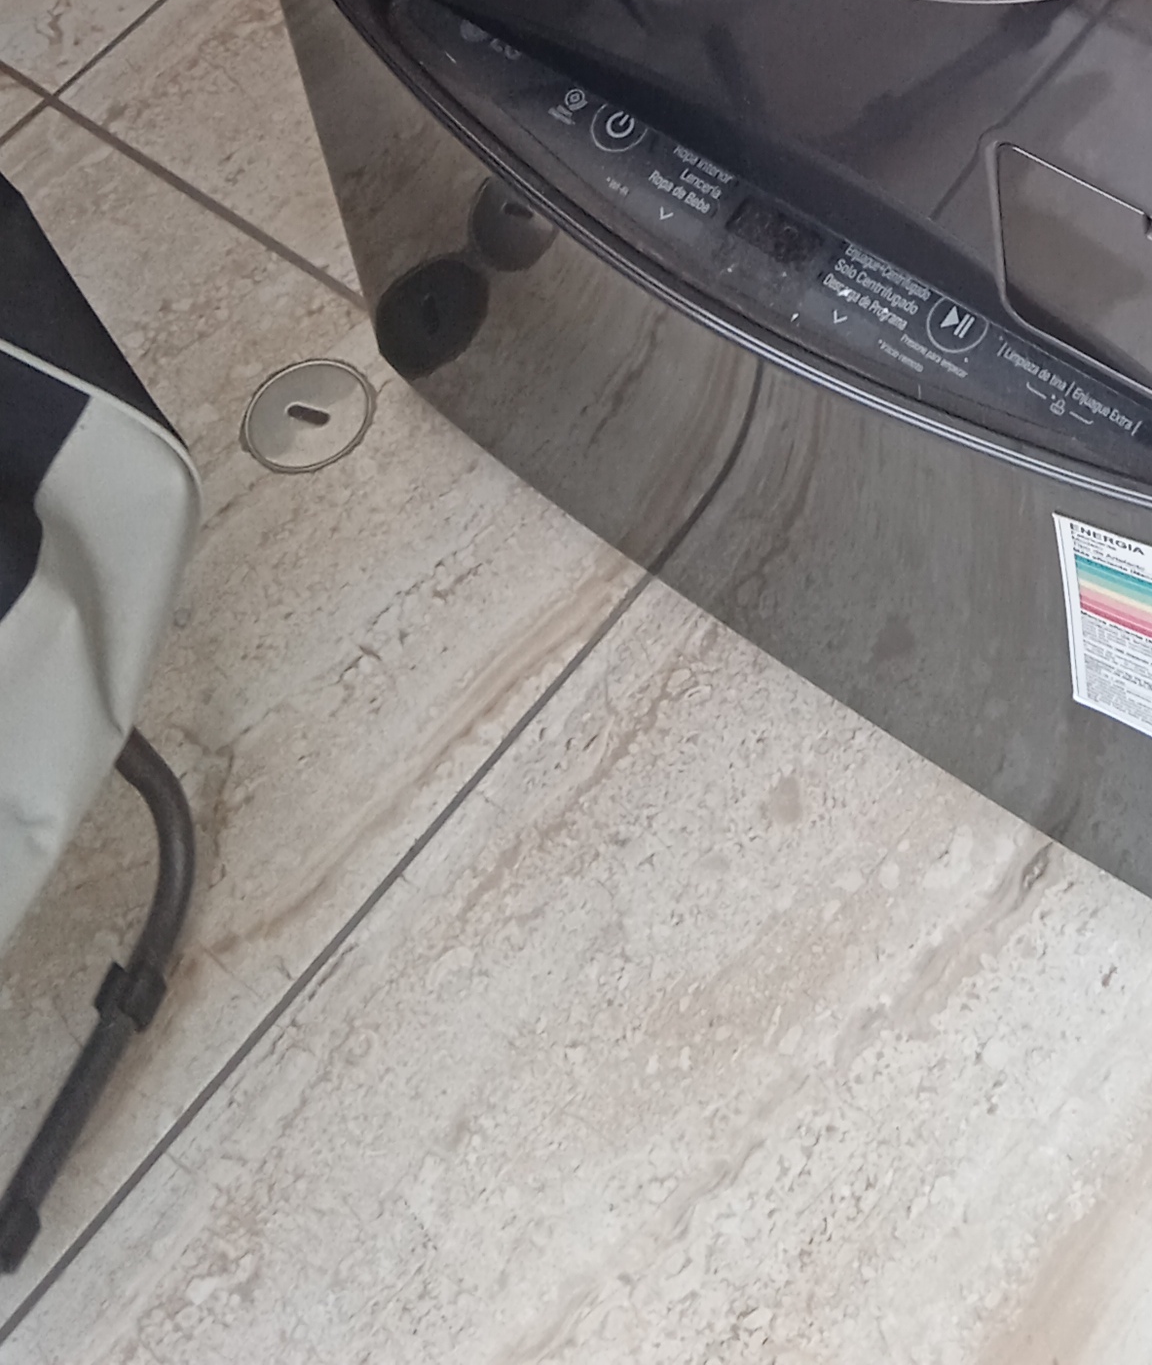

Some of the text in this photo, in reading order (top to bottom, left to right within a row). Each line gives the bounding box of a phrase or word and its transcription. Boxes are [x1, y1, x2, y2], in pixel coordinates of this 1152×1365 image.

[648, 170, 674, 194] Ropa
[856, 270, 919, 316] Centrifugado
[1072, 384, 1111, 418] Enjuague
[1109, 407, 1133, 431] Extra
